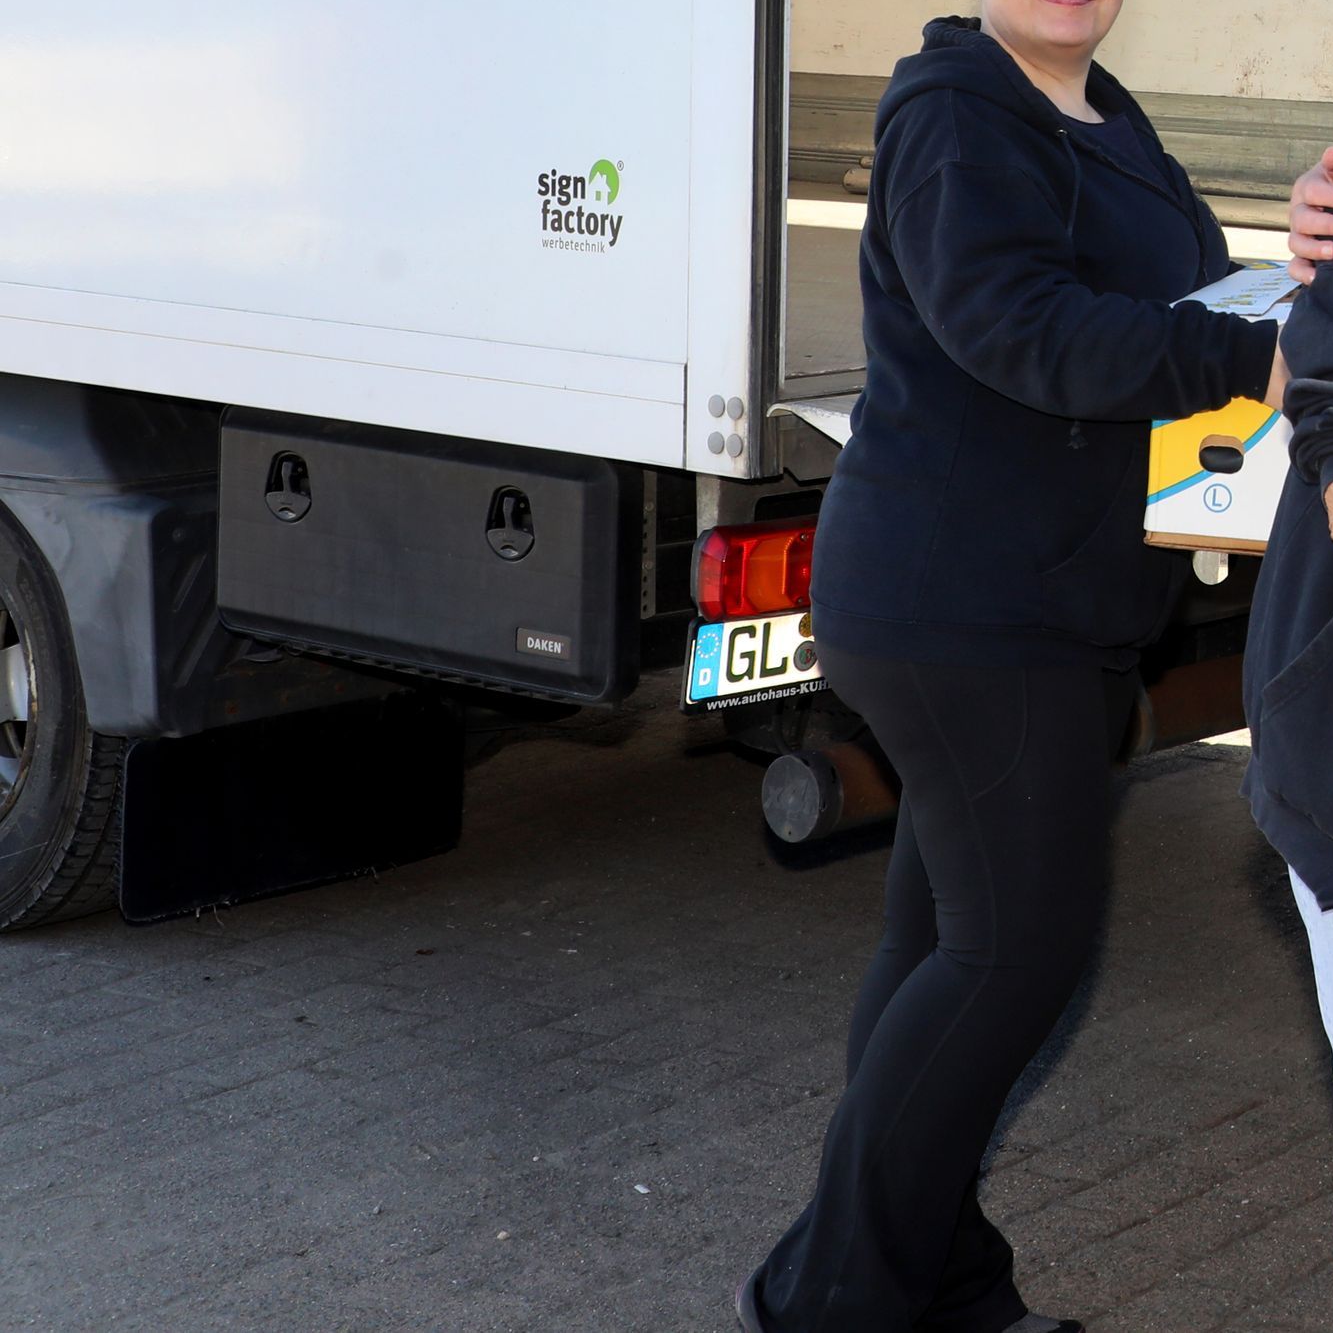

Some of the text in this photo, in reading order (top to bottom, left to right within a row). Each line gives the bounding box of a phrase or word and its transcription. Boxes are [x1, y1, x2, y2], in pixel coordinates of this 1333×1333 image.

[537, 169, 586, 206] sign
[541, 199, 623, 247] factory
[542, 237, 606, 254] werbetechnik
[1211, 488, 1223, 508] L
[527, 636, 562, 654] DAKEN
[726, 622, 788, 684] GL
[698, 668, 712, 686] D
